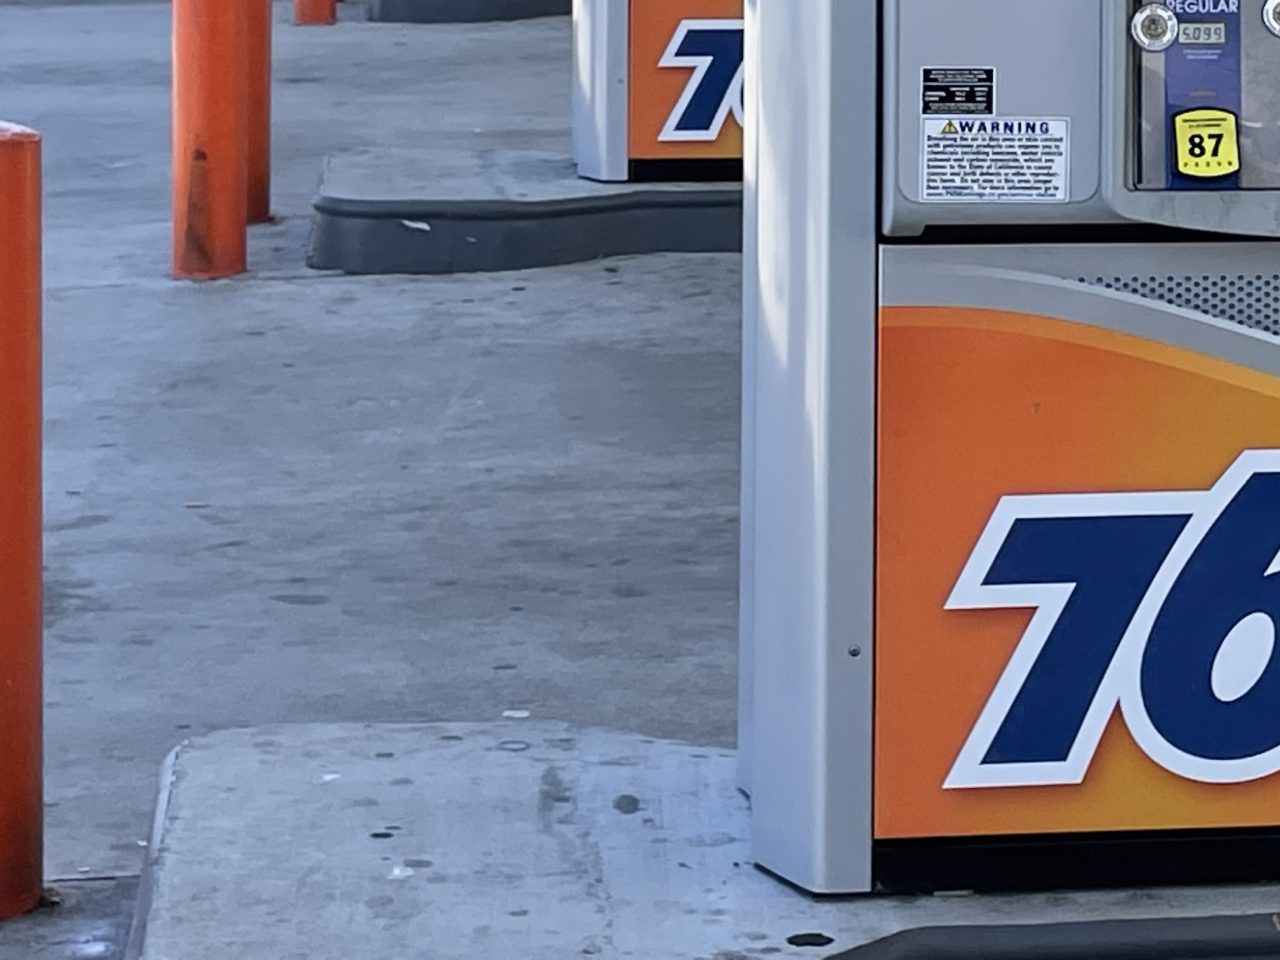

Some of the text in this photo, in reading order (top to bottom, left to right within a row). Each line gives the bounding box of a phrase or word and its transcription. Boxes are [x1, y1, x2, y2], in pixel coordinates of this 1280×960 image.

[656, 18, 745, 141] 7
[959, 121, 1050, 134] WARNING
[1188, 133, 1224, 158] 87
